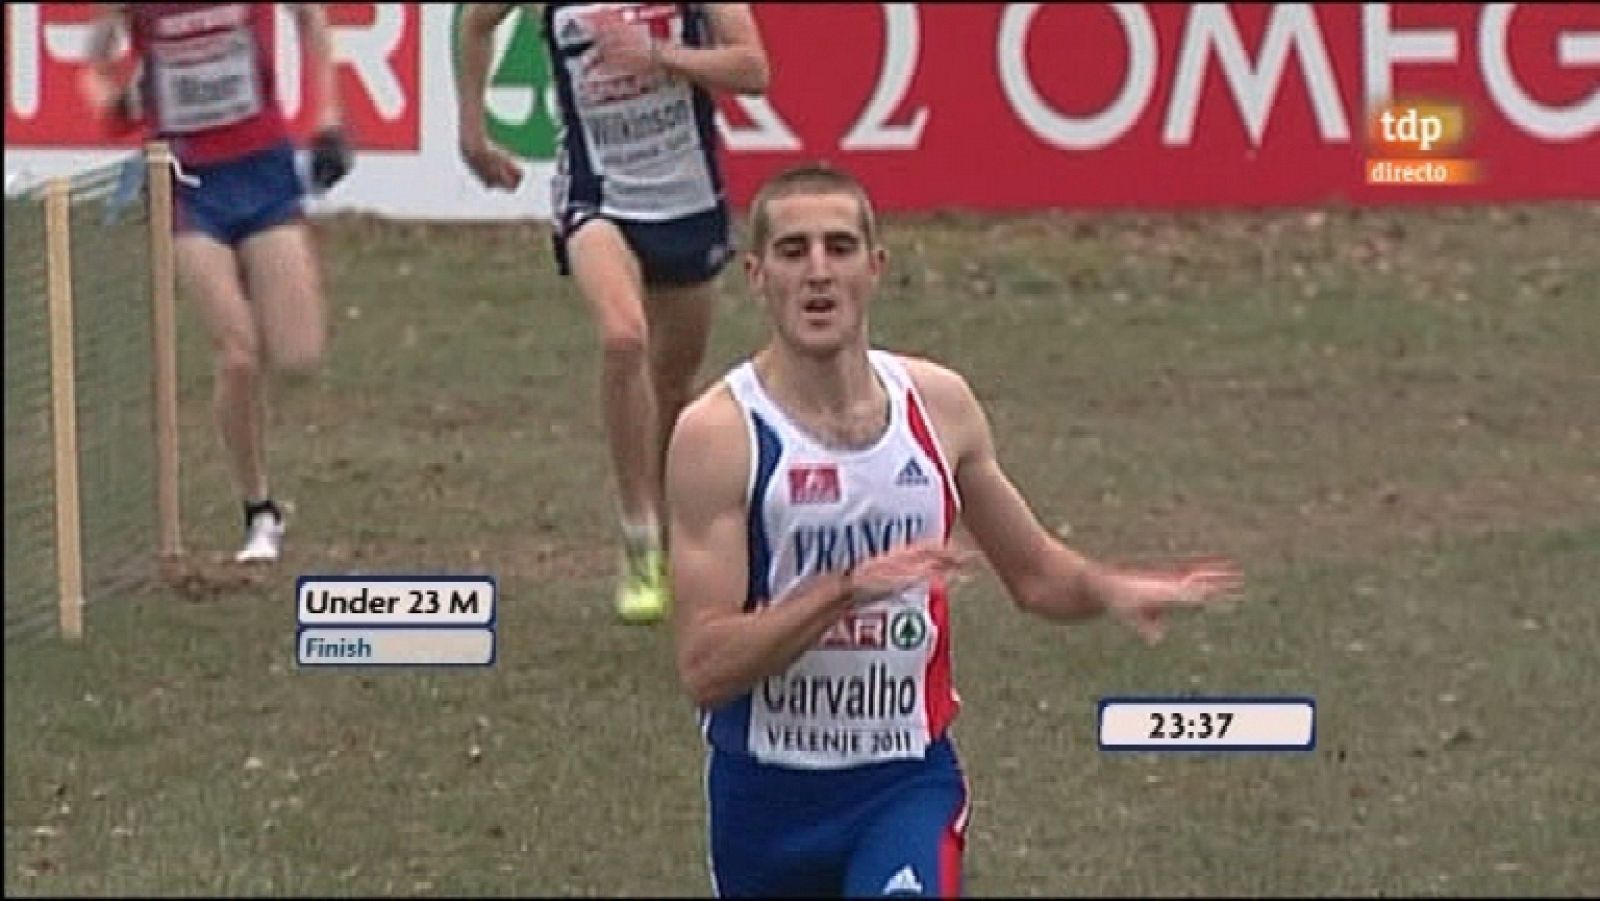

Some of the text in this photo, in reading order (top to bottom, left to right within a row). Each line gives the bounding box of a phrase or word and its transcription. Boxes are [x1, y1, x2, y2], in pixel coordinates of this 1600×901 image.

[588, 100, 692, 146] Wilkinson
[763, 662, 917, 720] Carvalho
[766, 727, 912, 754] VELENJE 2011
